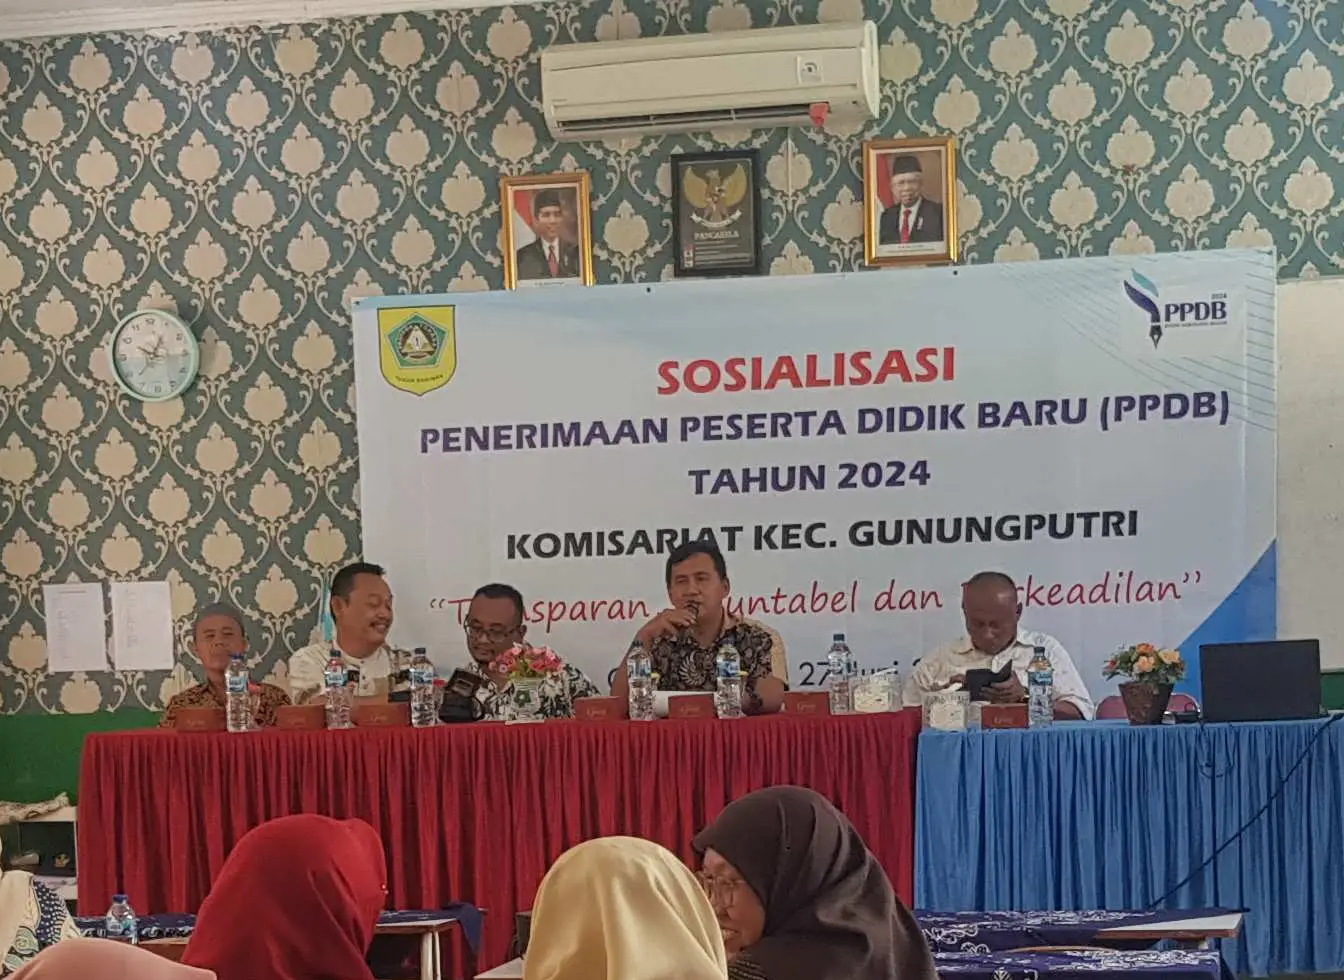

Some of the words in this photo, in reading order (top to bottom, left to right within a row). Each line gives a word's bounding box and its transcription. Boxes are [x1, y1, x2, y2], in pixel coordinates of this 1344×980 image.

[1164, 301, 1227, 322] PPDB
[657, 347, 955, 396] SOSIALISASI
[420, 417, 668, 454] PENERIMAAN
[680, 410, 847, 442] PESERTA
[857, 403, 966, 434] DIDIK
[977, 398, 1088, 429] BARU
[1100, 391, 1230, 432] (PPDB)
[688, 466, 825, 495] TAHUN
[838, 460, 931, 489] 2024
[754, 522, 837, 551] KEC.
[848, 510, 1138, 548] GUNUNGPUTRI
[874, 579, 943, 612] dan
